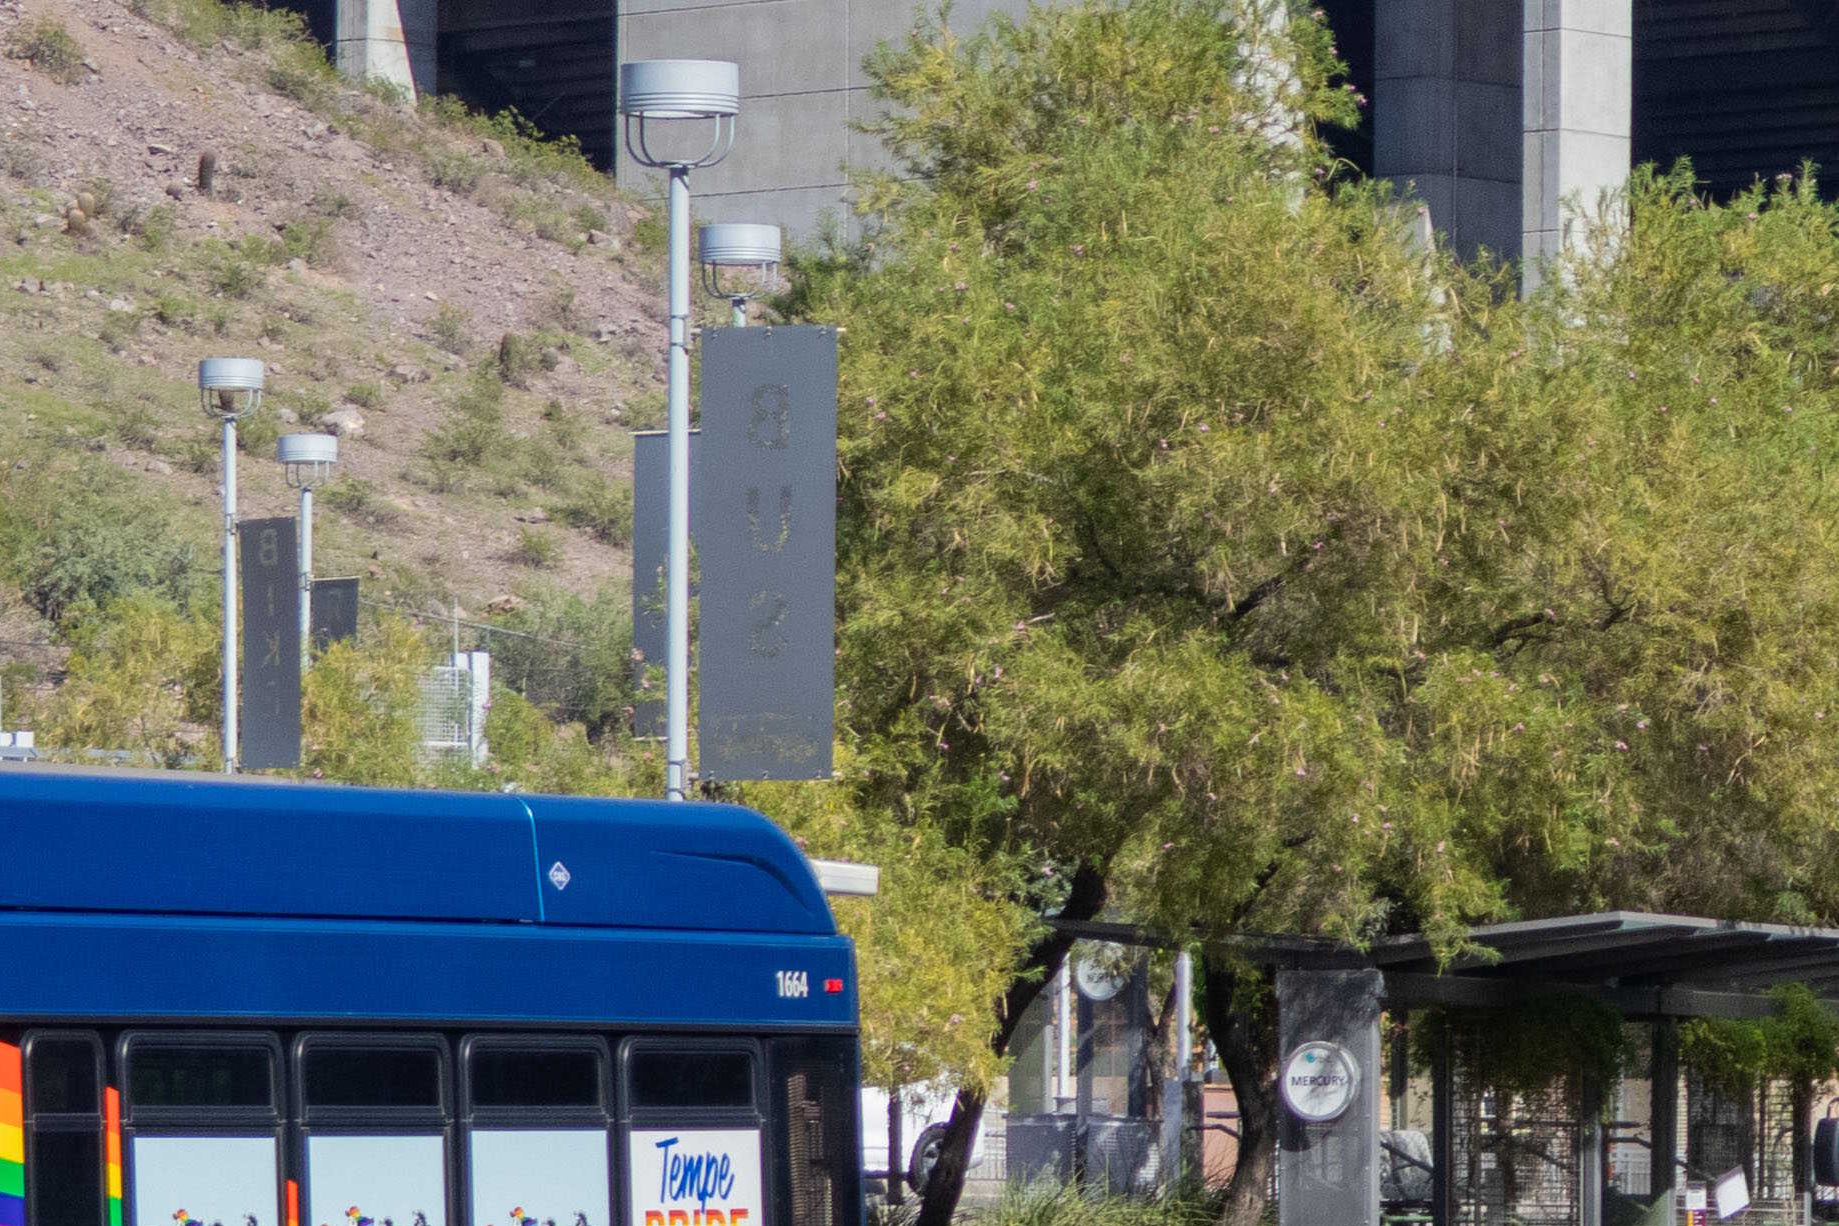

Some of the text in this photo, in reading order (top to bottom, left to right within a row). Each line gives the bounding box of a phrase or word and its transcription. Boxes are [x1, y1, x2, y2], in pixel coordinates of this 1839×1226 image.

[776, 970, 809, 998] 1664
[1290, 1074, 1346, 1087] MERCURY
[655, 1136, 736, 1215] Tempe
